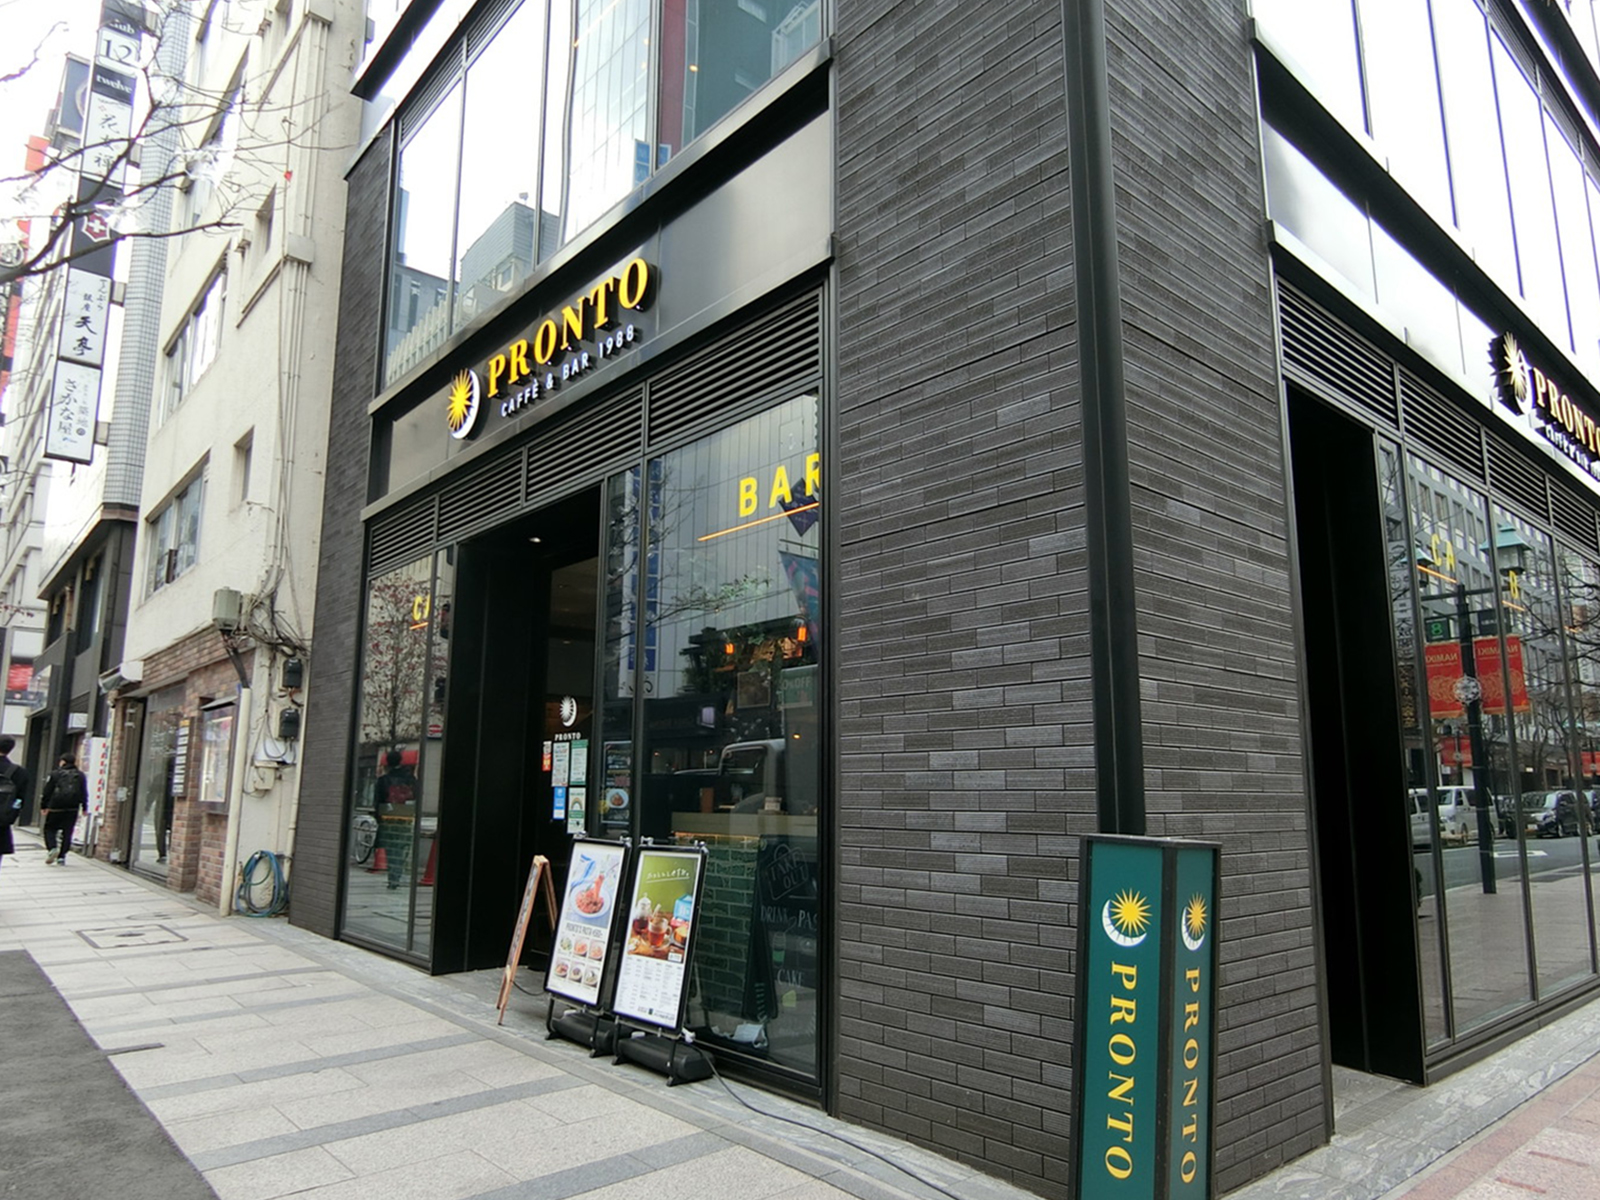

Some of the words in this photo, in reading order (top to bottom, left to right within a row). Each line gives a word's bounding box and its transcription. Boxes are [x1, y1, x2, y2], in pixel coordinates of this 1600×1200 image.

[102, 38, 133, 65] 12
[96, 73, 133, 94] twelve
[487, 258, 648, 398] PRONTO
[500, 378, 539, 417] CAFFÈ
[545, 373, 554, 390] &
[562, 352, 589, 381] BAR
[599, 324, 634, 359] 1988
[739, 452, 820, 518] BAR
[554, 732, 581, 741] PRONTO
[770, 850, 801, 881] TAKE
[783, 866, 811, 890] OUT
[760, 905, 789, 923] DRINK
[776, 968, 804, 988] CAKE
[1105, 961, 1138, 1179] PRONTO
[1181, 967, 1200, 1184] PRONTO
